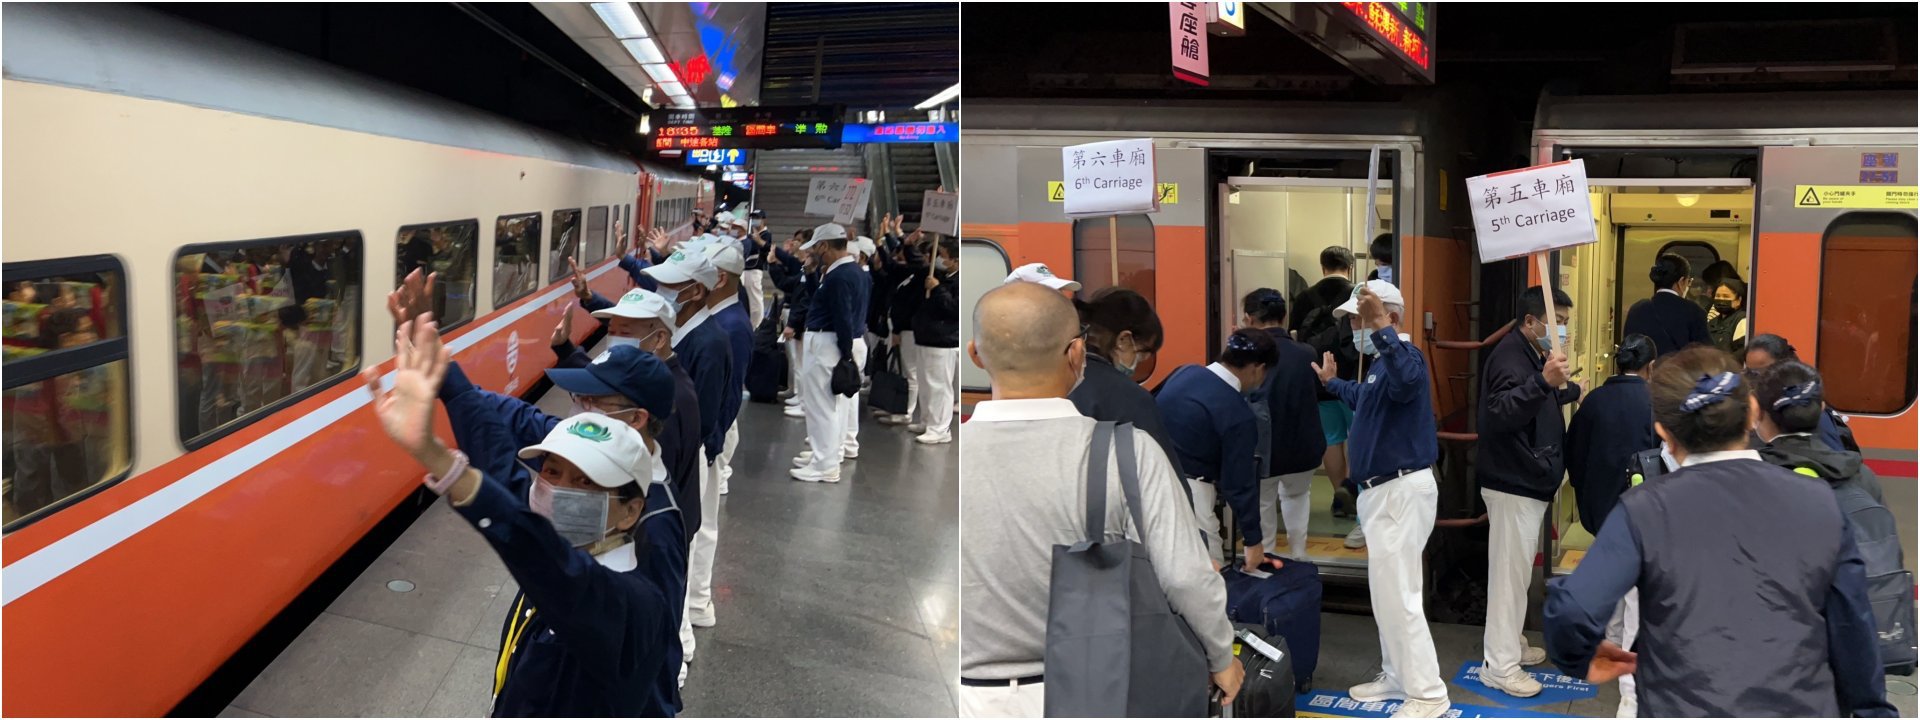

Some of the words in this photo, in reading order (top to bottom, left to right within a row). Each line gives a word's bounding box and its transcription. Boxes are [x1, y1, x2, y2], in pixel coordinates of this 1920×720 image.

[1072, 147, 1146, 170] 第六車廂
[1075, 176, 1091, 190] 6th
[1093, 177, 1143, 190] Carriage
[1482, 174, 1576, 210] 第五車廂
[1491, 215, 1511, 232] 5th
[1515, 207, 1576, 228] Carriage
